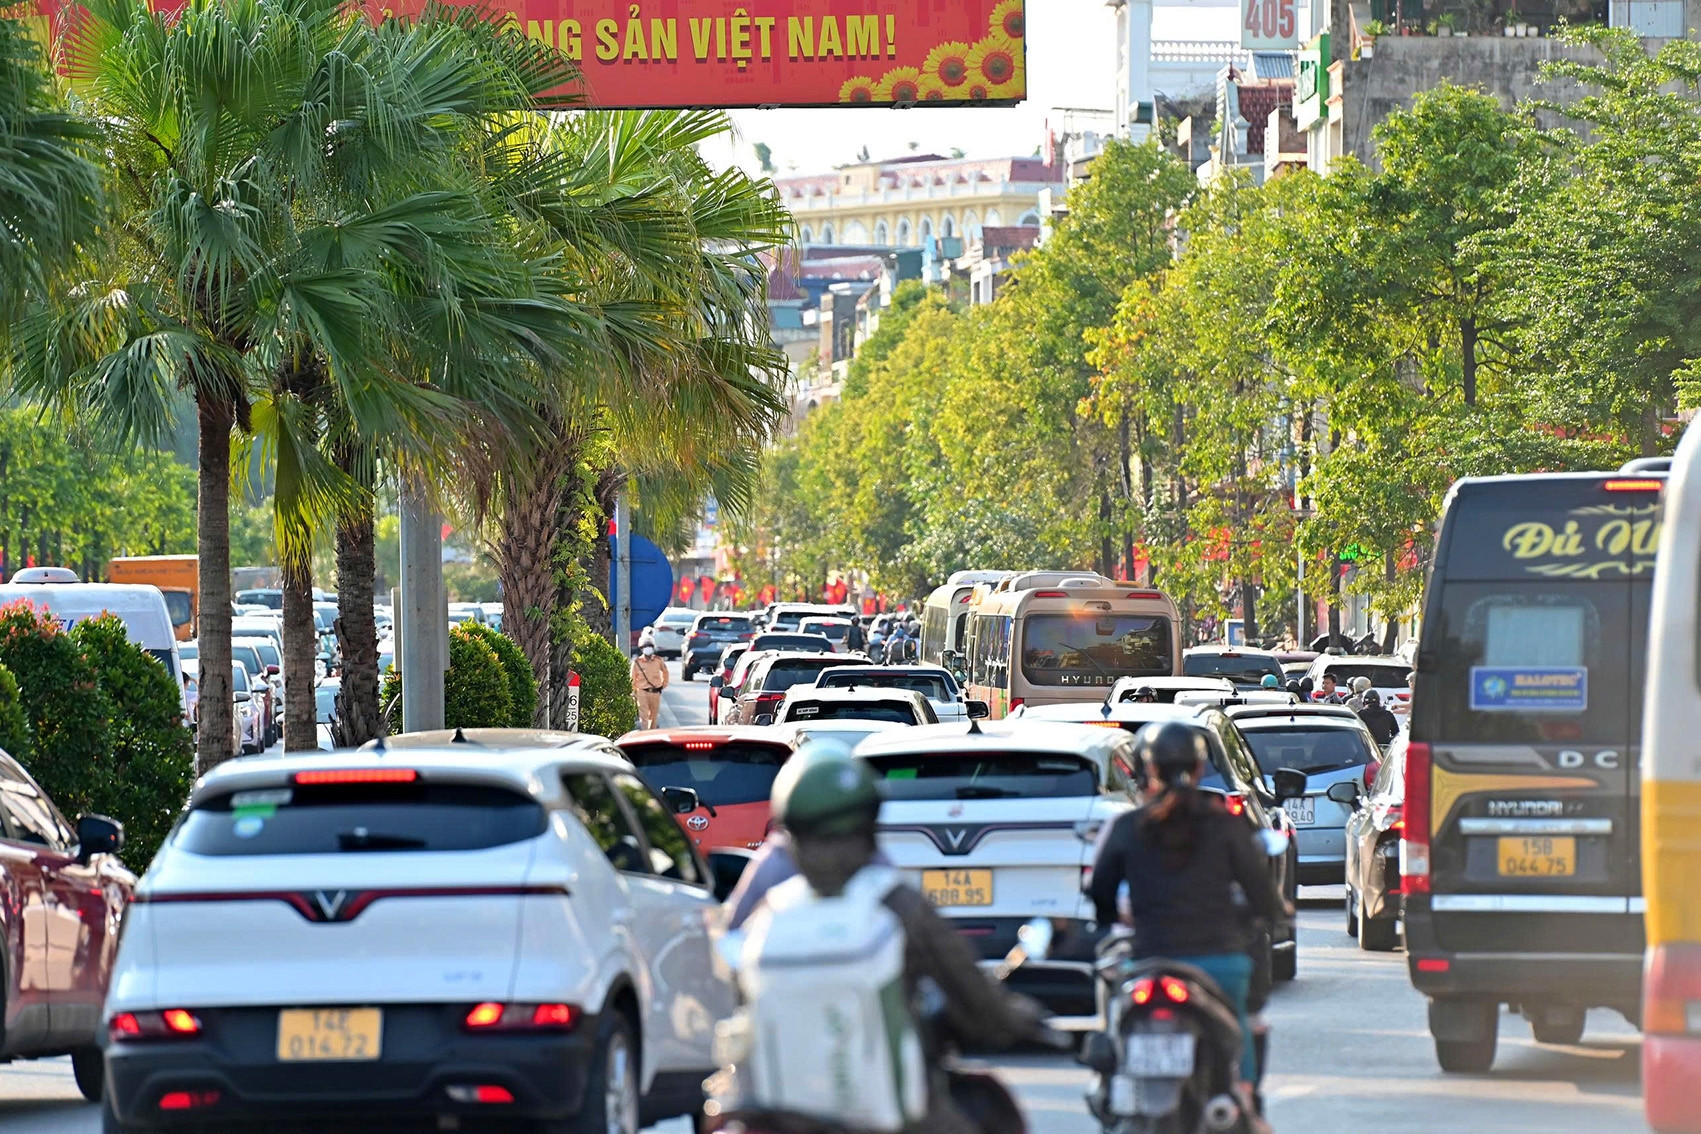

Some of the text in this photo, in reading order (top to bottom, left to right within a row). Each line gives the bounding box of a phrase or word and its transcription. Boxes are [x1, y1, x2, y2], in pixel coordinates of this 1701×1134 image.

[1245, 0, 1295, 38] 405
[595, 3, 677, 60] SẢN
[689, 8, 776, 68] VIỆT
[787, 14, 896, 60] NAM!
[1488, 801, 1563, 815] HYUNDAI
[944, 872, 972, 886] 14A
